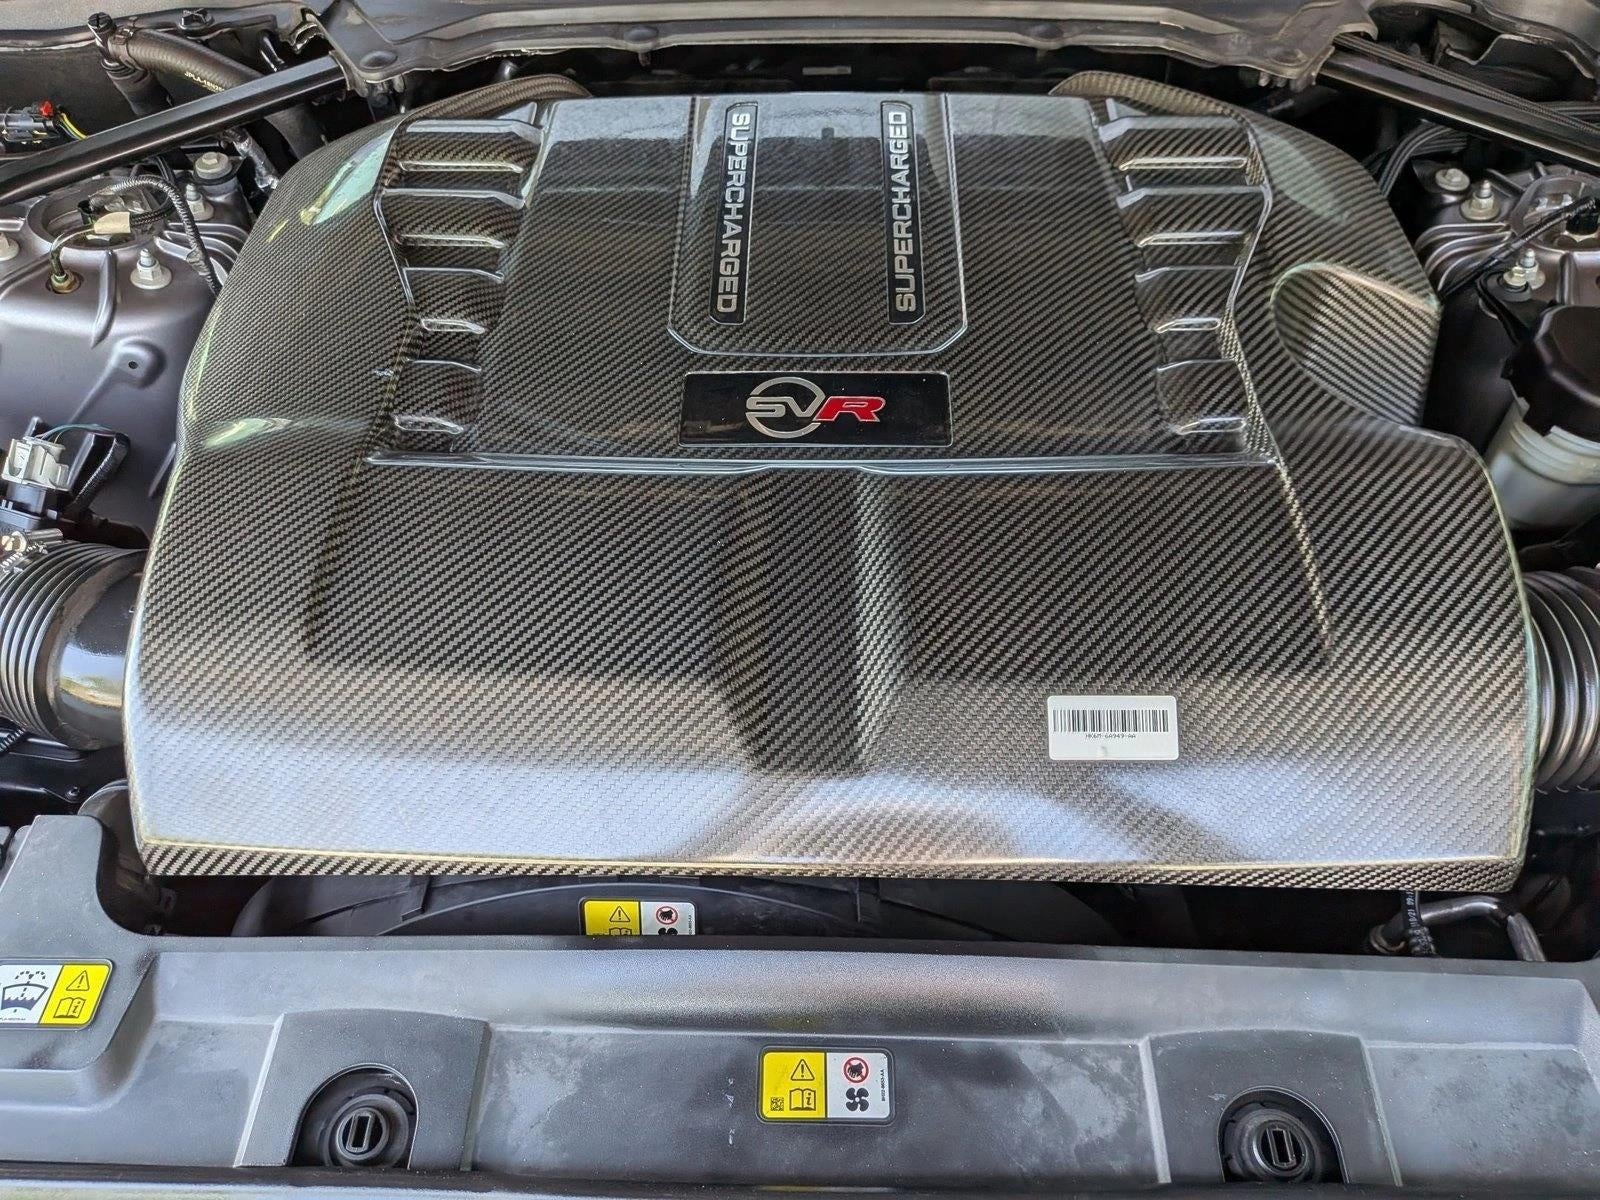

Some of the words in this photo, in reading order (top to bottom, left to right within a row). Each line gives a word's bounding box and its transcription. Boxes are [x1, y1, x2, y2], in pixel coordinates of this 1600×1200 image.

[716, 112, 750, 313] SUPERCHARGED
[888, 111, 917, 312] SUPERCHARGED
[746, 395, 886, 423] SVR
